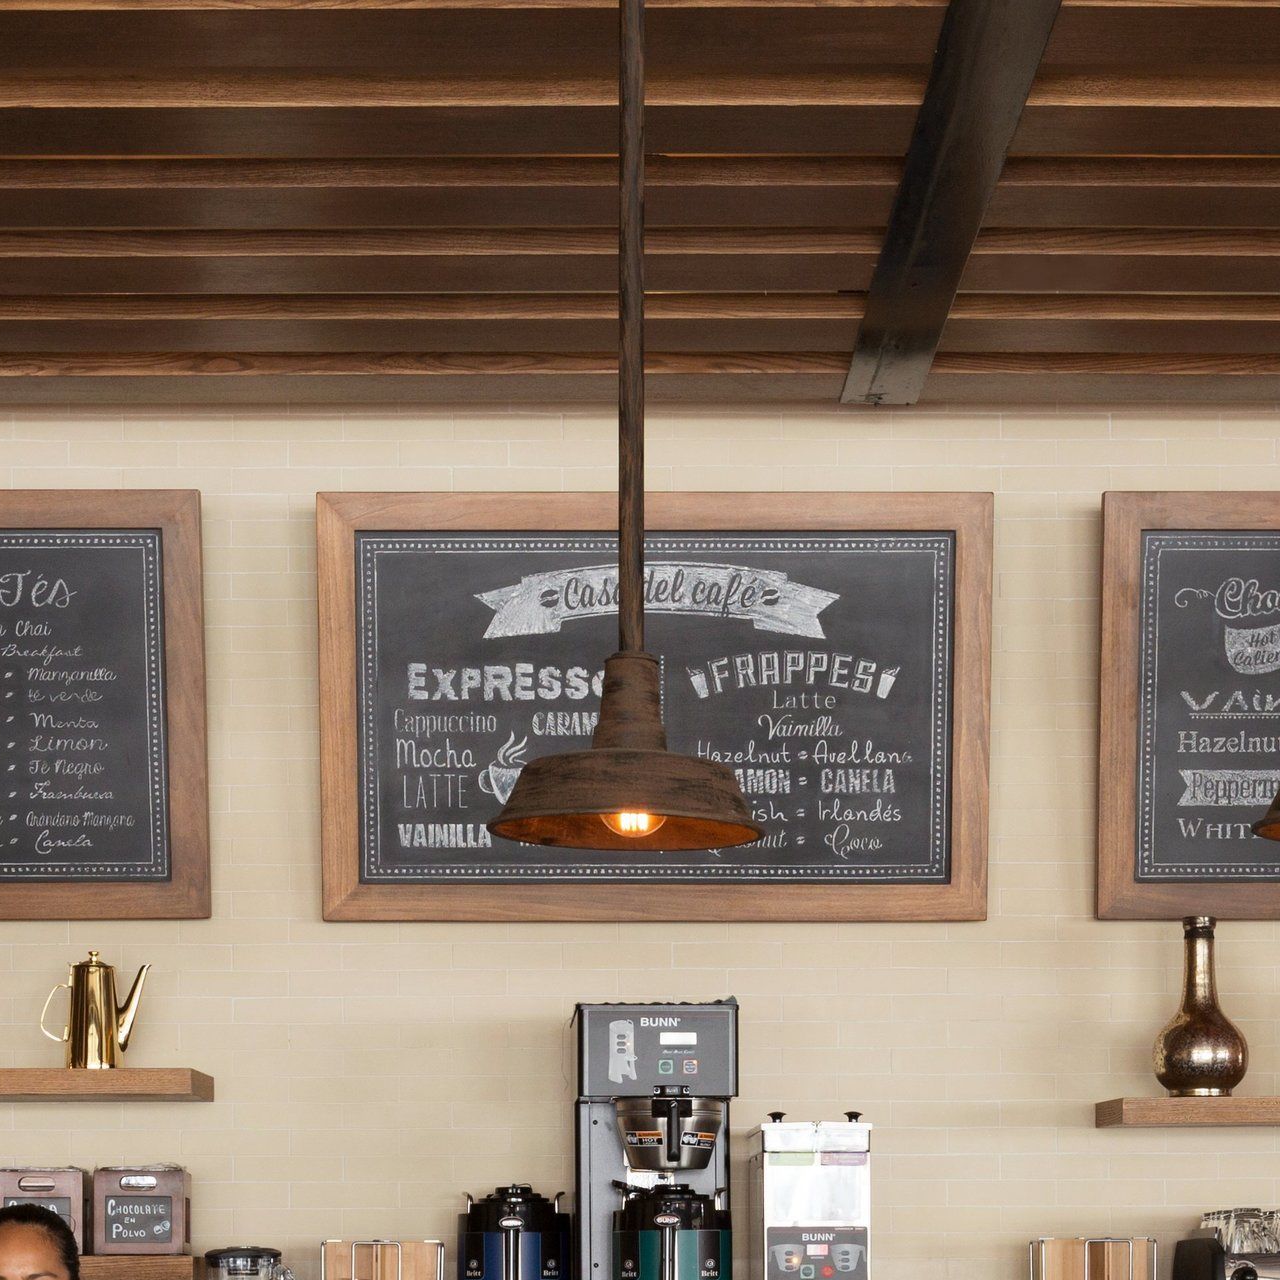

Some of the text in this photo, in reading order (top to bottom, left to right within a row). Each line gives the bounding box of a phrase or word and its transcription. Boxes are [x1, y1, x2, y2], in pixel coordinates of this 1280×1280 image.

[691, 572, 756, 618] café
[15, 620, 52, 637] Chai
[1246, 630, 1275, 647] Hot
[1, 643, 83, 666] Breakfast
[27, 667, 118, 685] Manzanilla
[707, 650, 877, 694] FRAPPES
[49, 688, 103, 702] verde
[772, 689, 837, 709] Latte
[30, 712, 99, 729] Menta
[393, 709, 600, 737] Cappuccino CARAM
[757, 714, 843, 740] Vainilla
[396, 738, 476, 768] Mocha
[697, 739, 791, 763] Hazelnut
[54, 759, 105, 780] Negro
[821, 768, 895, 794] CANELA
[29, 781, 114, 800] Frambuesa
[402, 773, 468, 809] LATTE
[751, 798, 902, 822] ish Irlandés
[34, 829, 95, 855] Canela
[398, 823, 492, 848] VAINILLA
[824, 823, 883, 859] Coco
[107, 1199, 166, 1216] CHOCOLATE
[112, 1223, 146, 1239] POLVO
[621, 1270, 637, 1278] Britt
